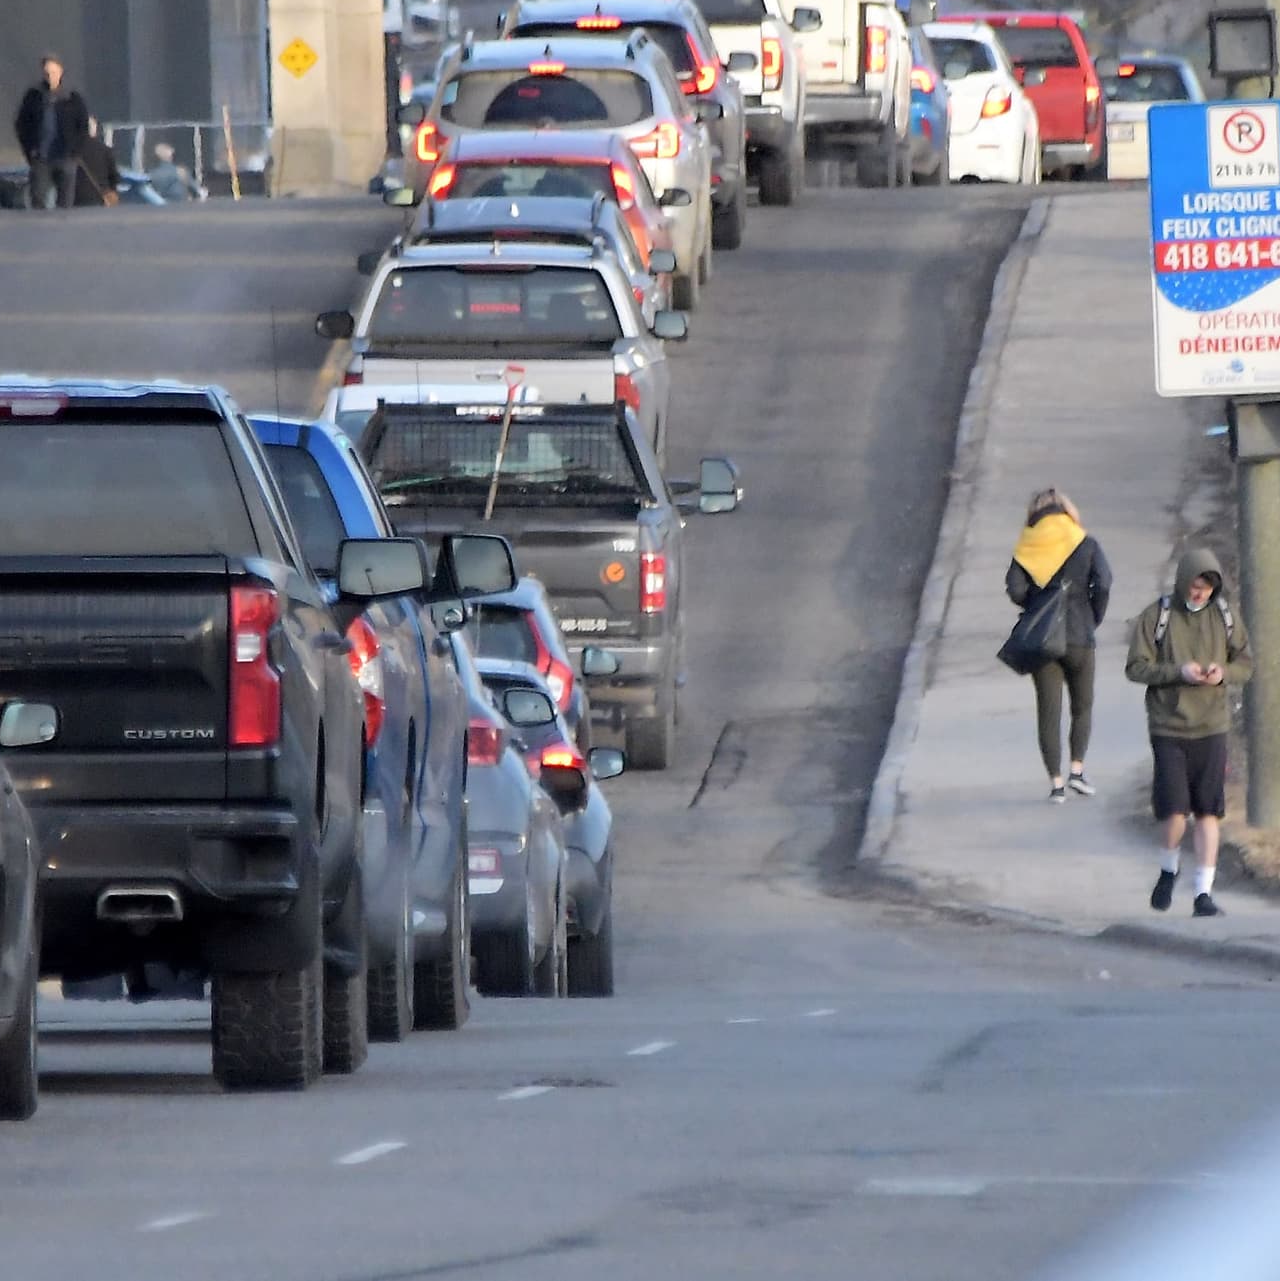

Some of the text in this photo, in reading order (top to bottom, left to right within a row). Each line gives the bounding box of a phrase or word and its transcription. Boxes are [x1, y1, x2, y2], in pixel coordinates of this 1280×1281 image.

[1216, 164, 1230, 177] 21
[1258, 162, 1266, 175] 7
[1183, 192, 1271, 214] LORSQUE
[1163, 219, 1211, 240] FEUX
[1163, 242, 1209, 270] 418
[123, 728, 215, 740] CUSTOM
